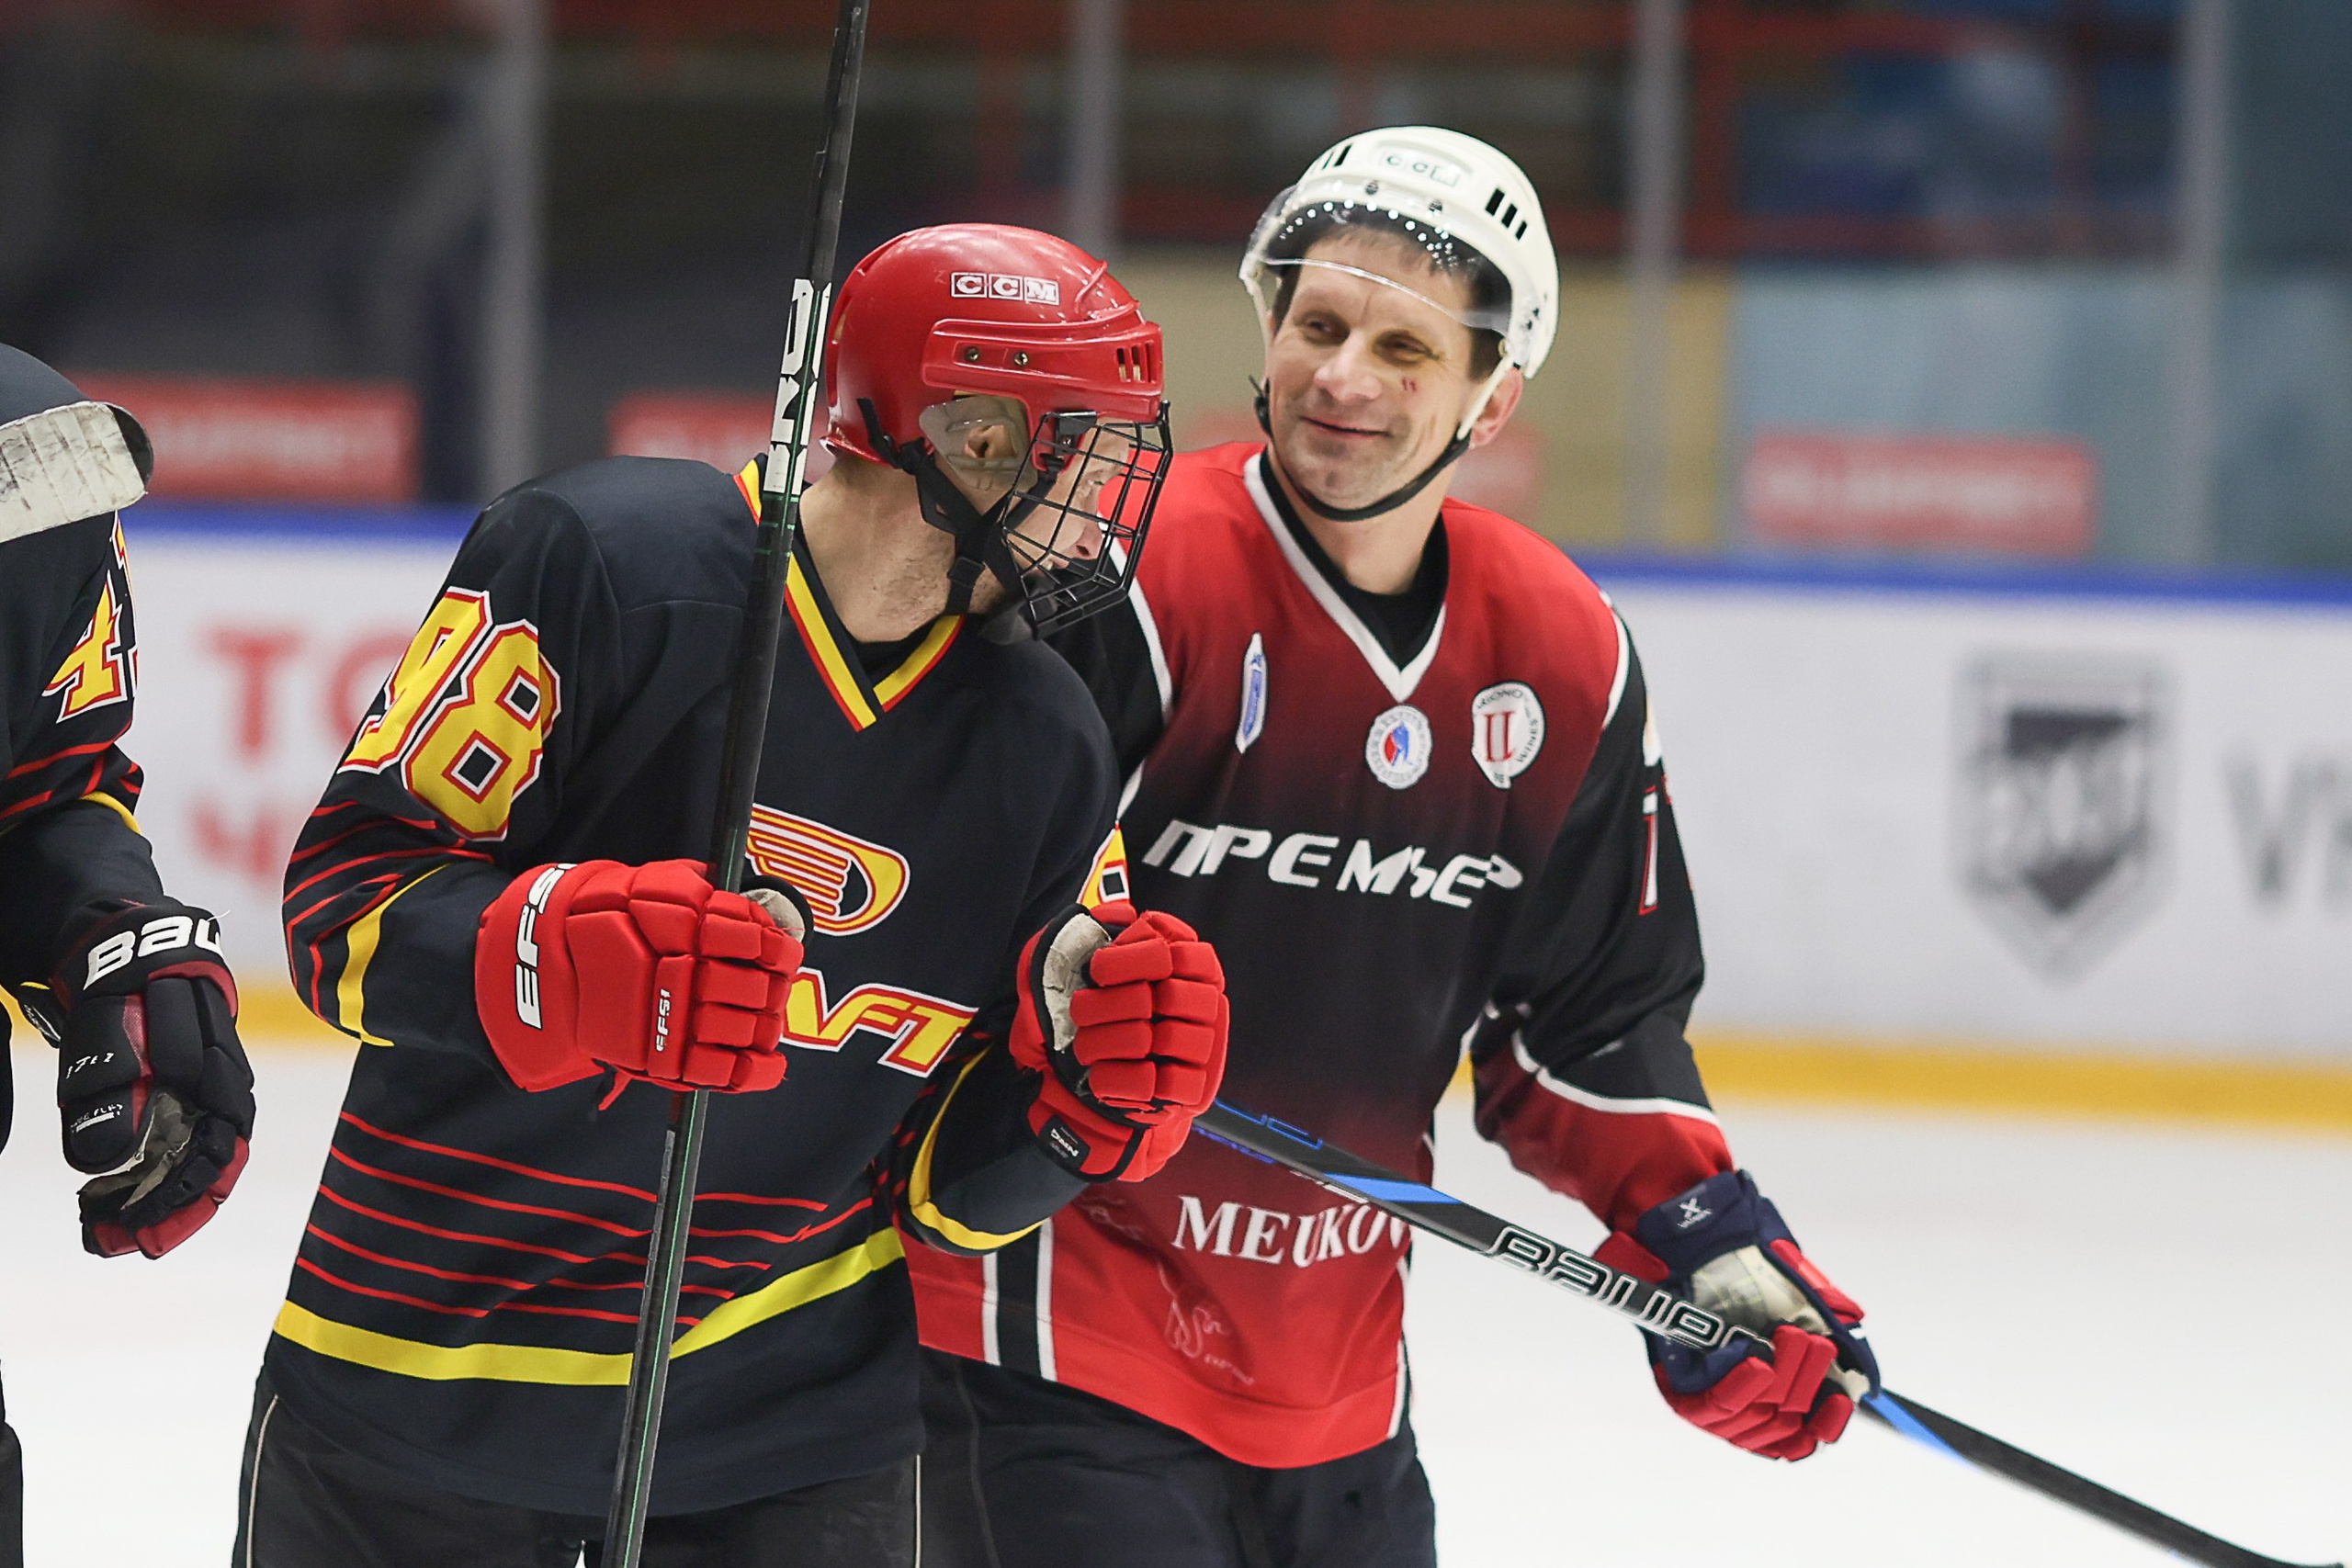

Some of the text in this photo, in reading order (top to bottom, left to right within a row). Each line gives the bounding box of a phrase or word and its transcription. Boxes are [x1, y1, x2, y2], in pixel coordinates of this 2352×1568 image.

[1382, 152, 1461, 186] CC
[951, 272, 1059, 305] CCM
[41, 510, 138, 724] 4
[337, 586, 561, 841] 98
